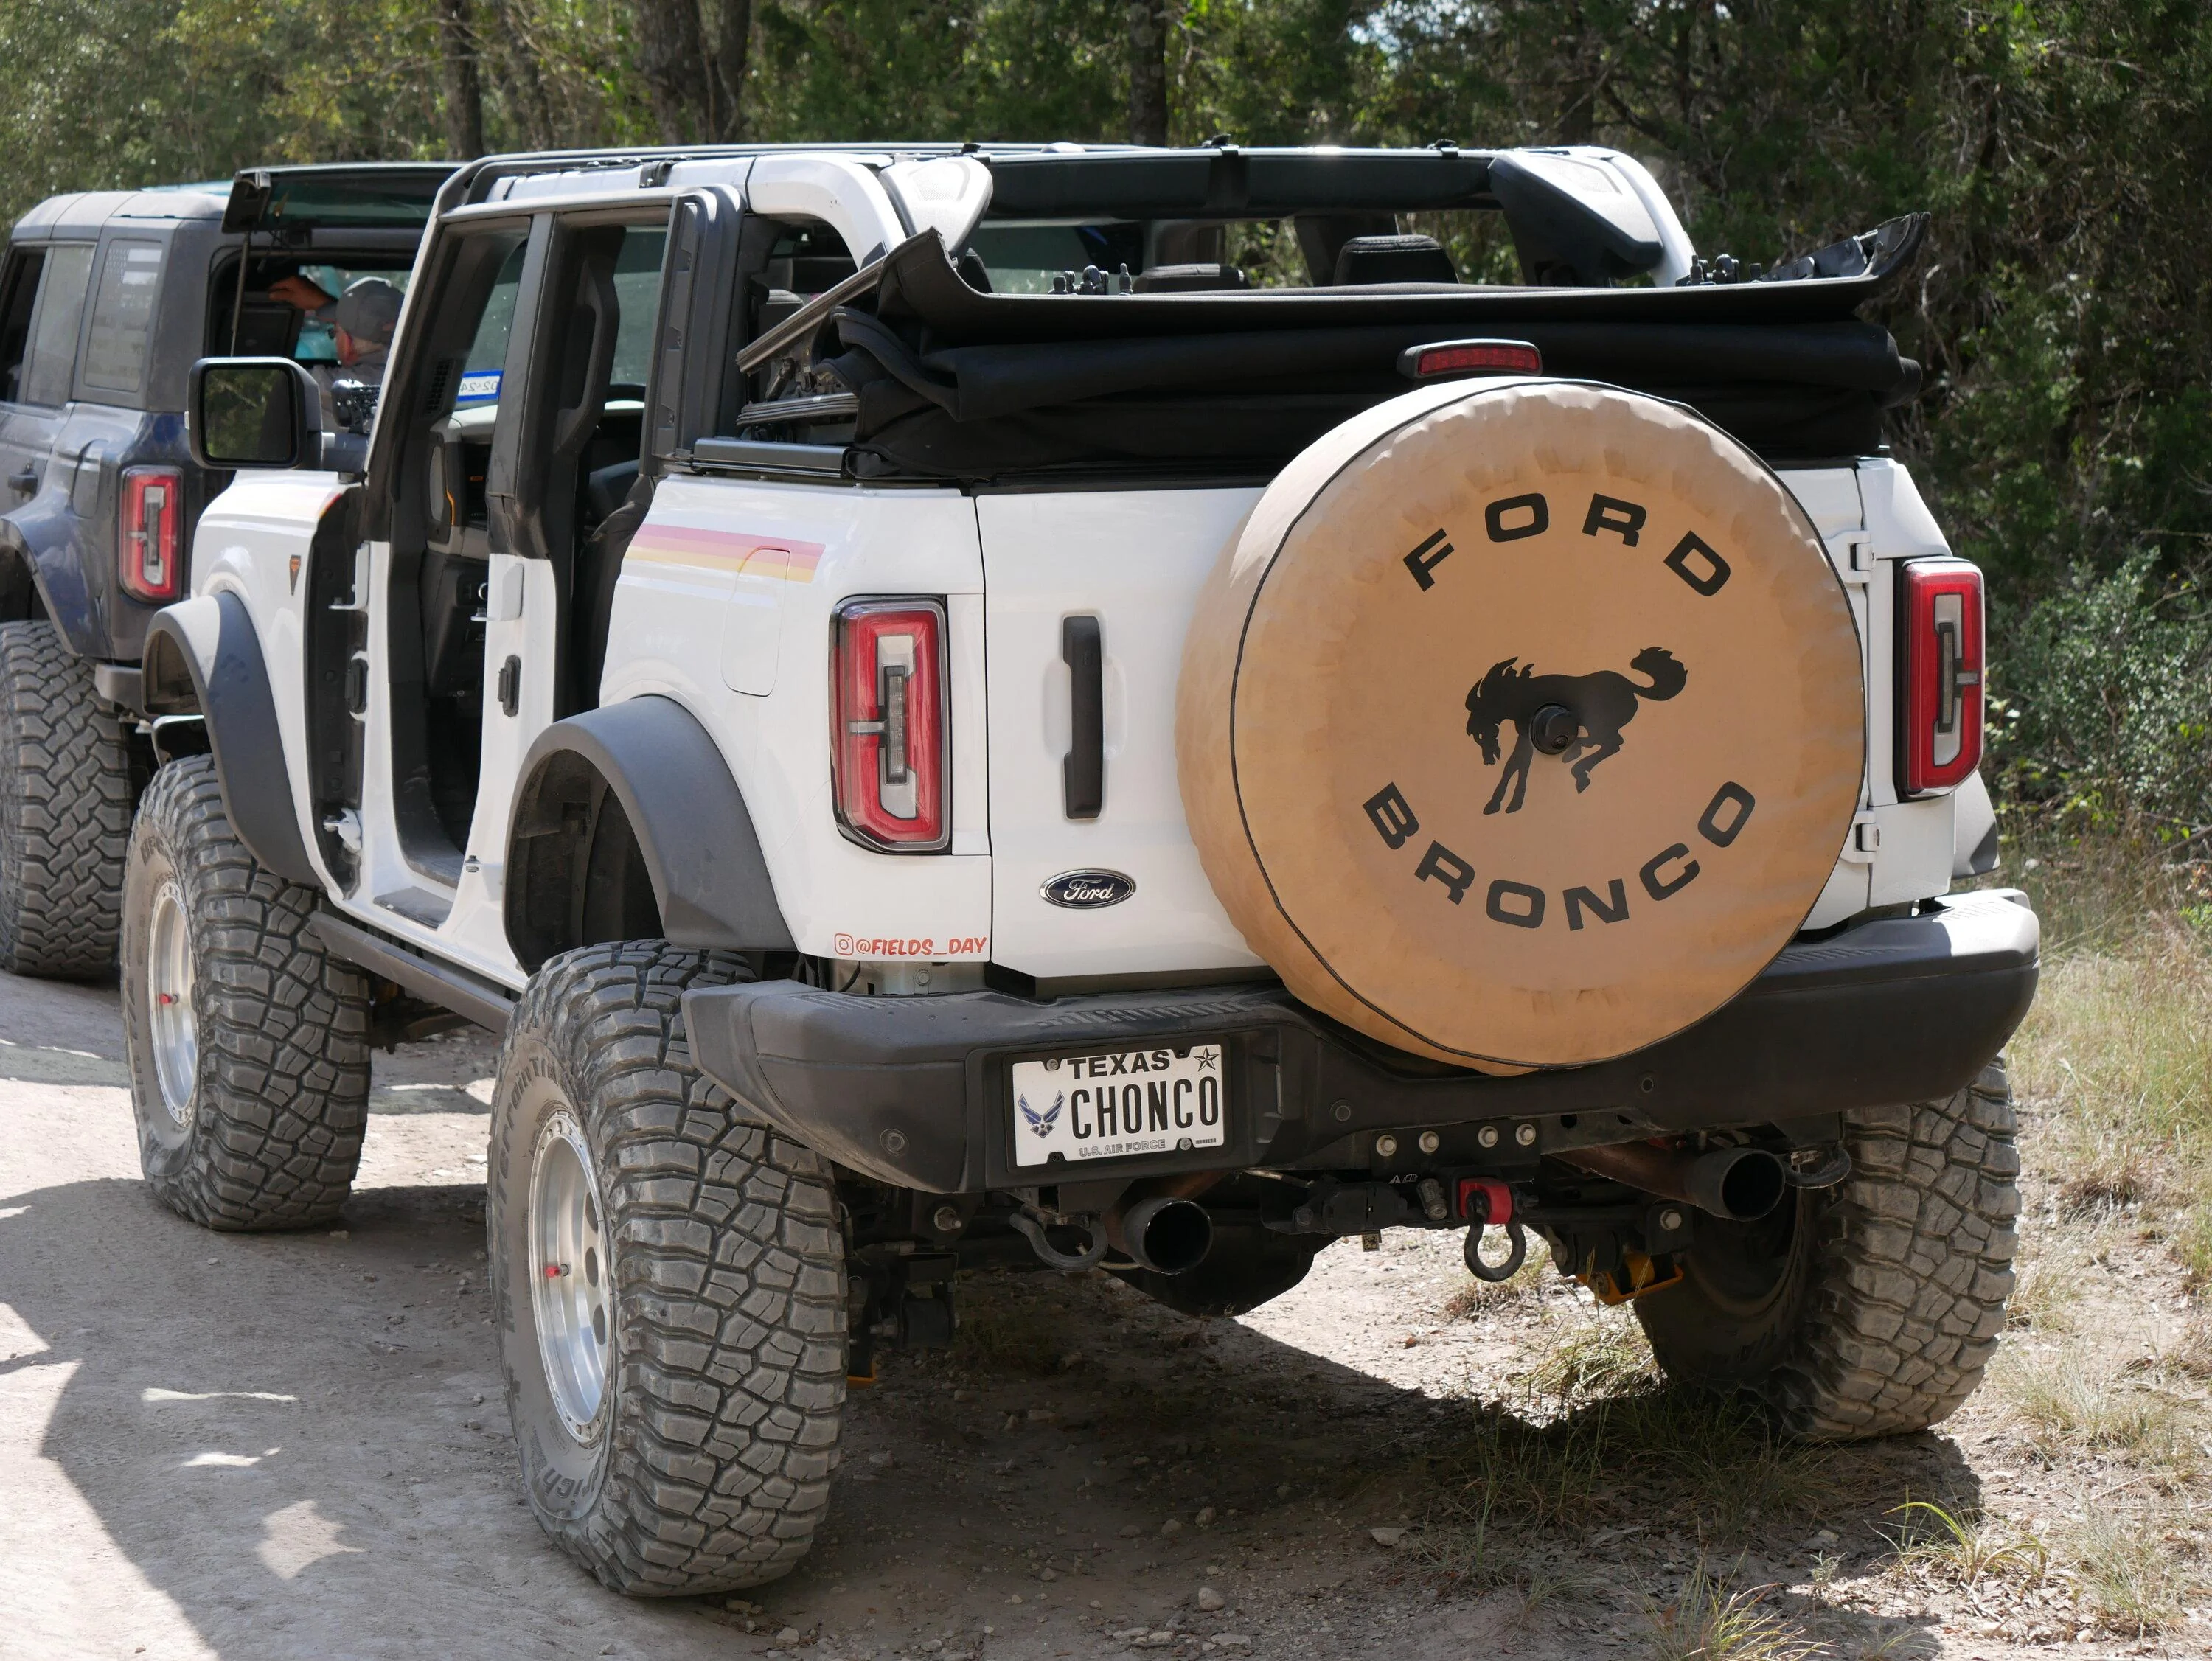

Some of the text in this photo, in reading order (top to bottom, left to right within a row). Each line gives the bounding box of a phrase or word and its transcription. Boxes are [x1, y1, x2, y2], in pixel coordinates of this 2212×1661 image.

[1402, 492, 1731, 597] FORD
[1362, 781, 1756, 931] BRONCO
[1063, 878, 1114, 901] Ford
[855, 936, 987, 956] @FIELDS_DAY
[1067, 1050, 1171, 1079] TEXAS
[1071, 1076, 1219, 1140] CHONCO
[1079, 1139, 1166, 1157] U.S. AIR FORCE
